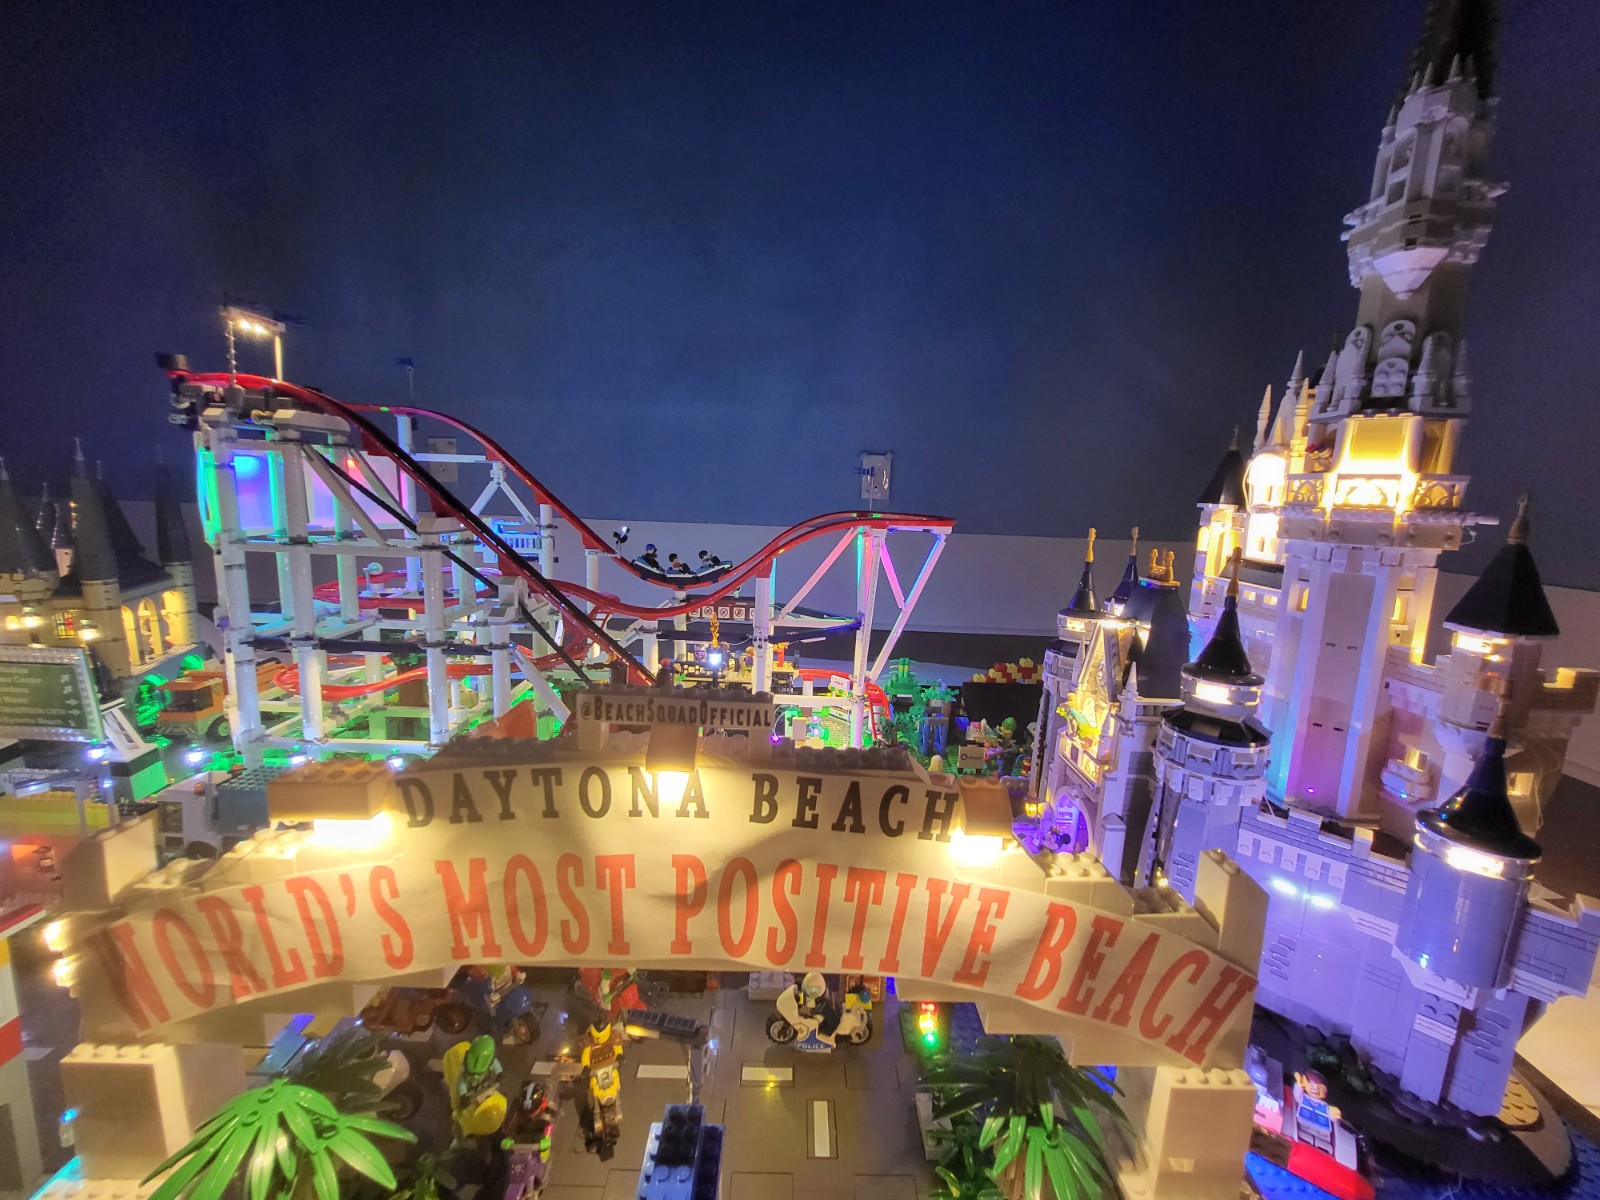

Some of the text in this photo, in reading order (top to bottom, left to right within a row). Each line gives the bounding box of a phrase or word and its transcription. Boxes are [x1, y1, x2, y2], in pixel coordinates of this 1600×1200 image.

[396, 766, 959, 842] DAYTONA BEACH
[434, 853, 636, 960] MOST
[670, 854, 1010, 988] POSITIVE
[1014, 902, 1259, 1066] BEACH
[796, 1042, 825, 1050] POLICE
